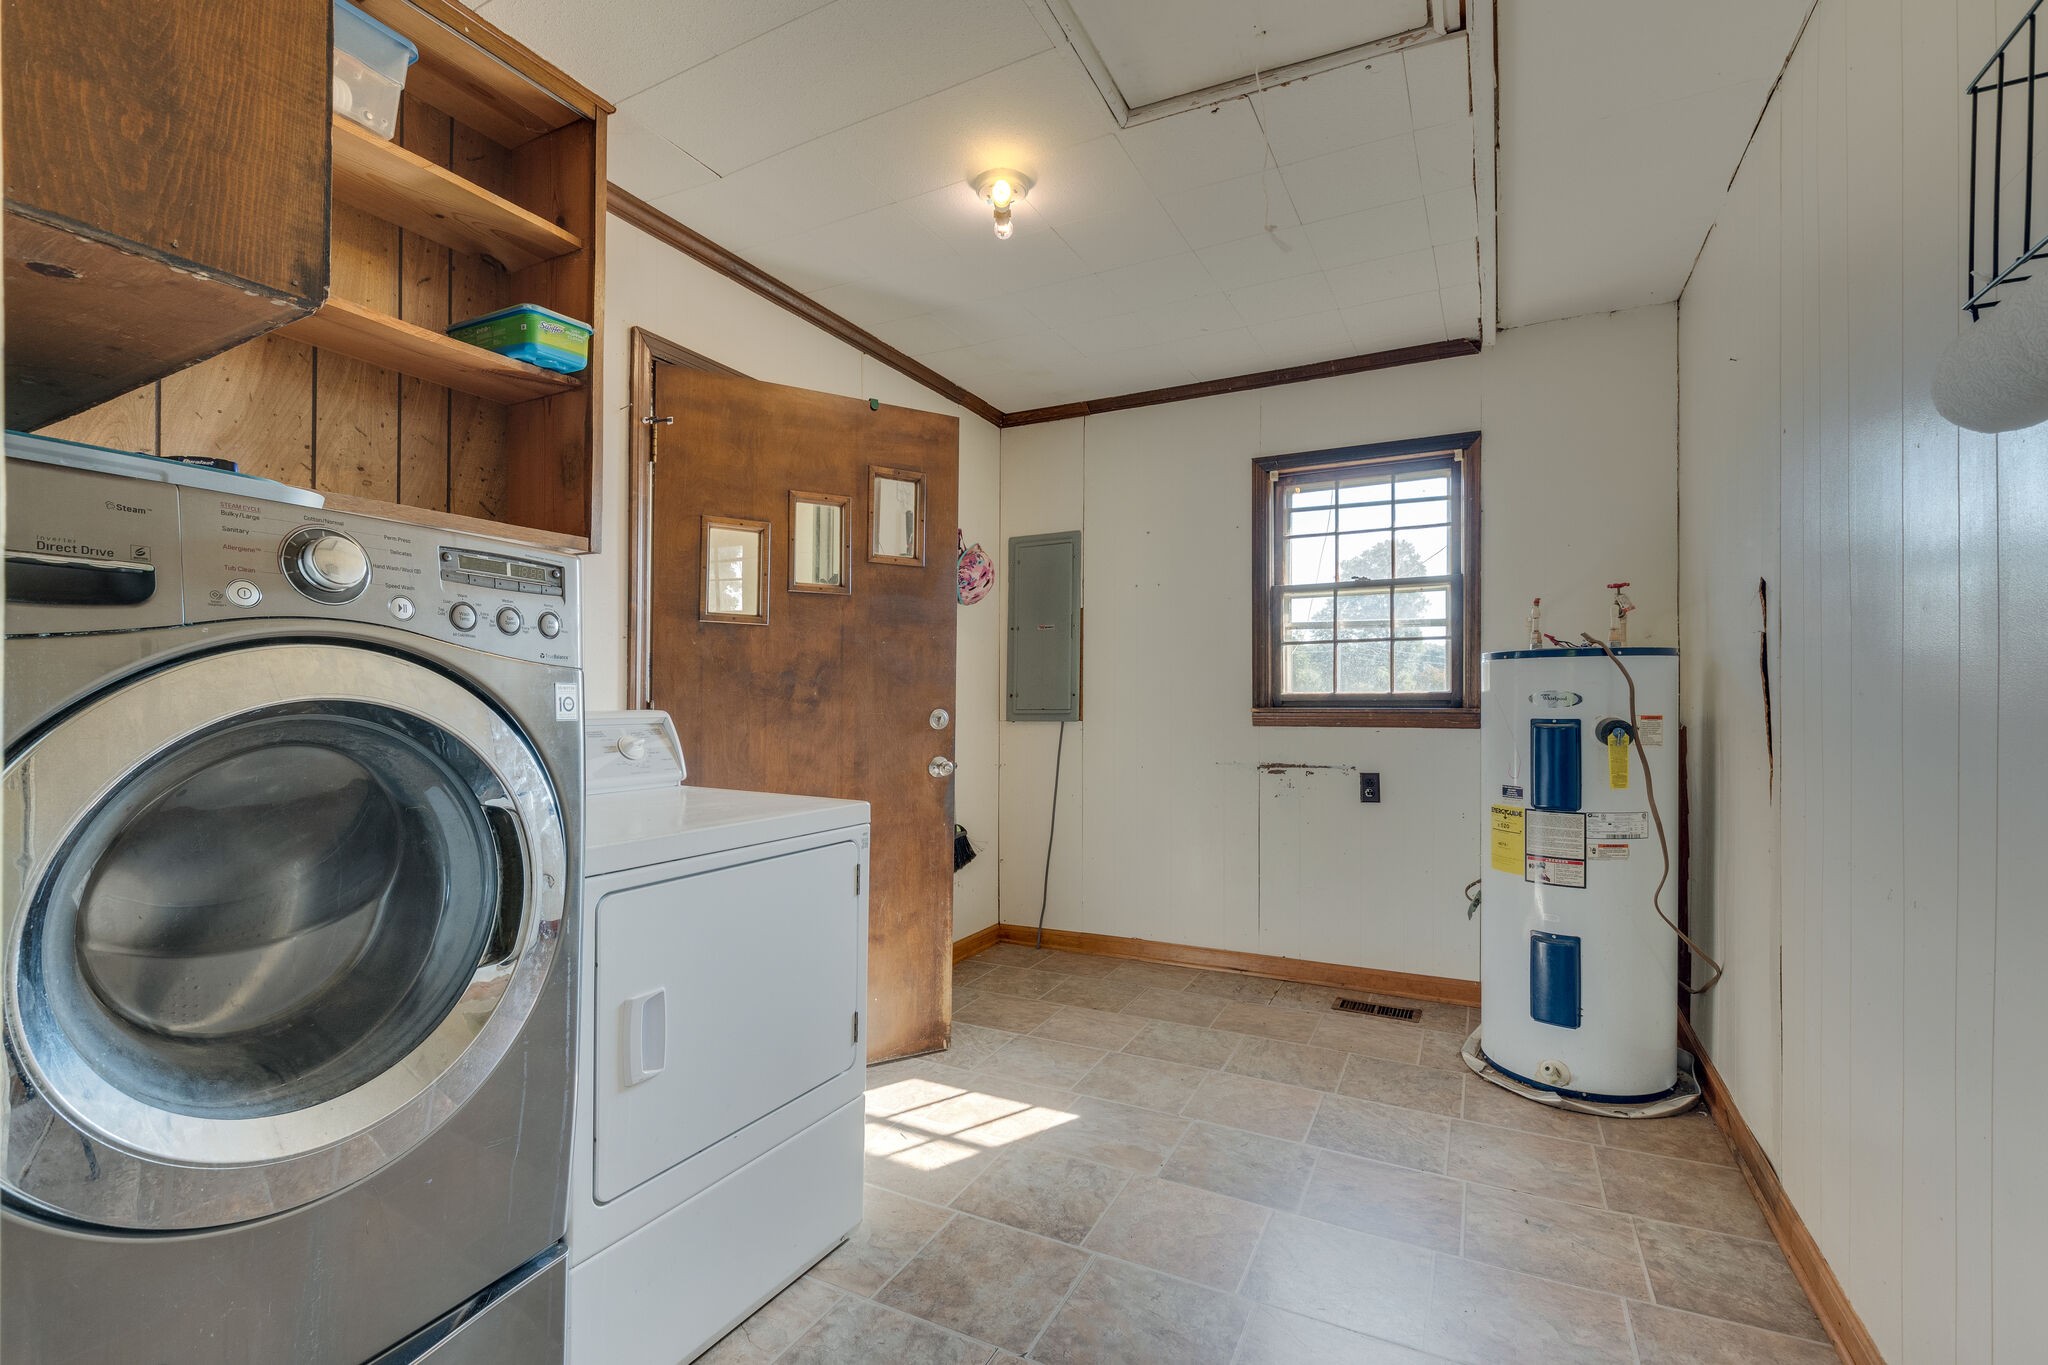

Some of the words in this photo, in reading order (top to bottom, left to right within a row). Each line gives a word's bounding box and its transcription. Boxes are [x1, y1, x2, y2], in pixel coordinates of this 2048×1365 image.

[220, 501, 241, 510] STEAM
[220, 510, 260, 520] Bulky/Large
[304, 515, 344, 526] Cotton/Normal
[221, 525, 250, 535] Sanitary
[36, 534, 77, 543] Inverter
[36, 540, 77, 553] Direct
[81, 545, 114, 557] Drive
[390, 548, 412, 557] Delicates
[224, 564, 237, 572] Tub
[237, 565, 256, 574] Clean
[385, 583, 400, 591] Speed
